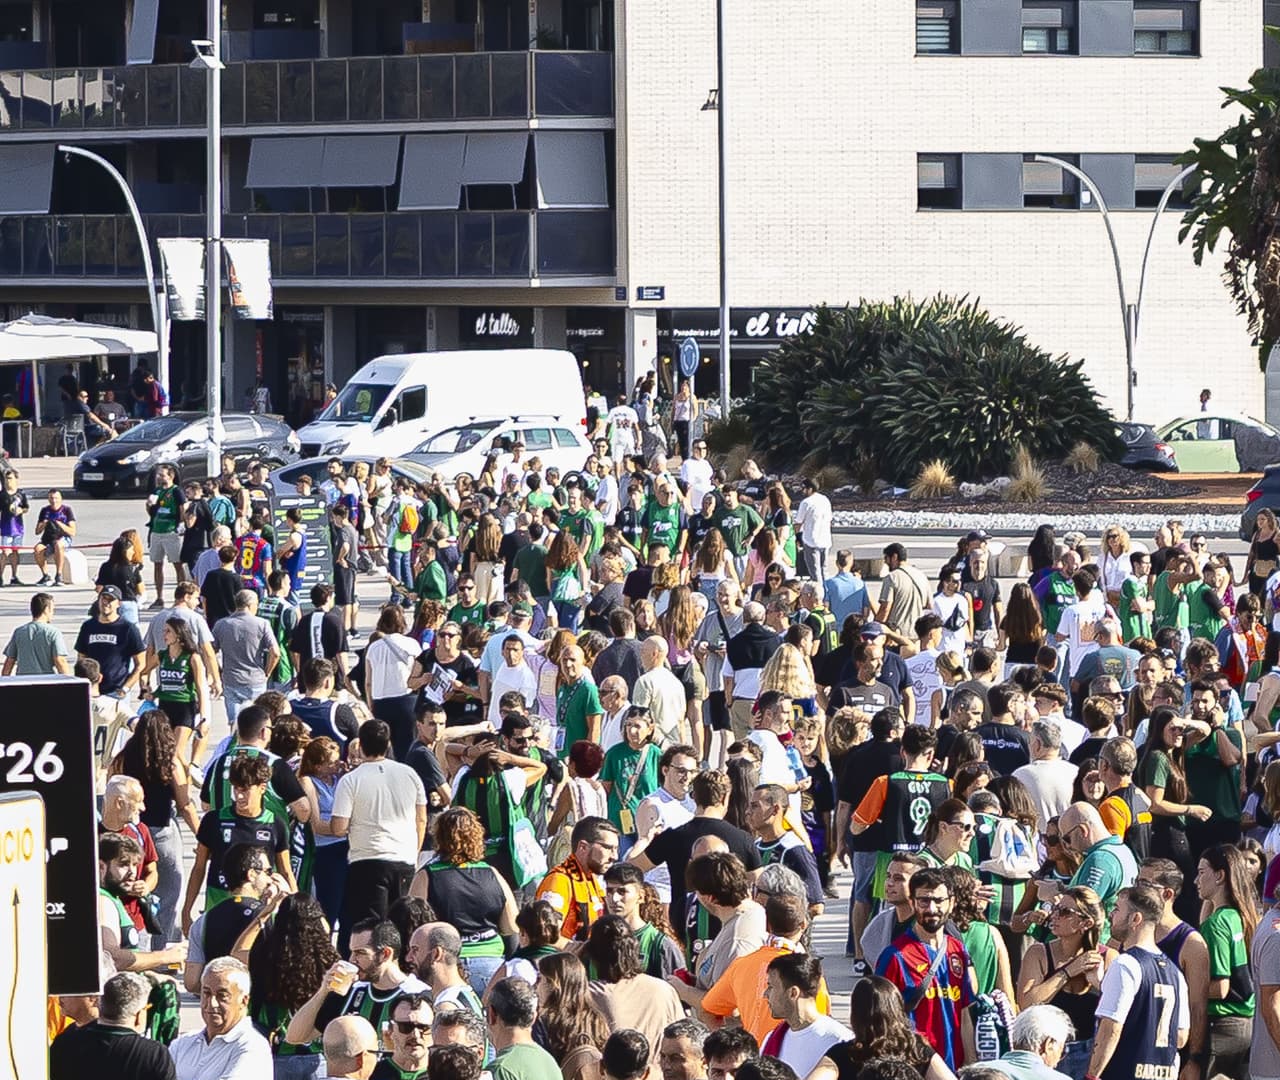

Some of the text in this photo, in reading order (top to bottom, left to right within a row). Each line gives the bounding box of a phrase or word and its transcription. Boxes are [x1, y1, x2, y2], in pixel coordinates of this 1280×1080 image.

[476, 313, 519, 335] el taller
[746, 312, 770, 336] el
[910, 797, 931, 835] 9
[1153, 983, 1176, 1047] 7
